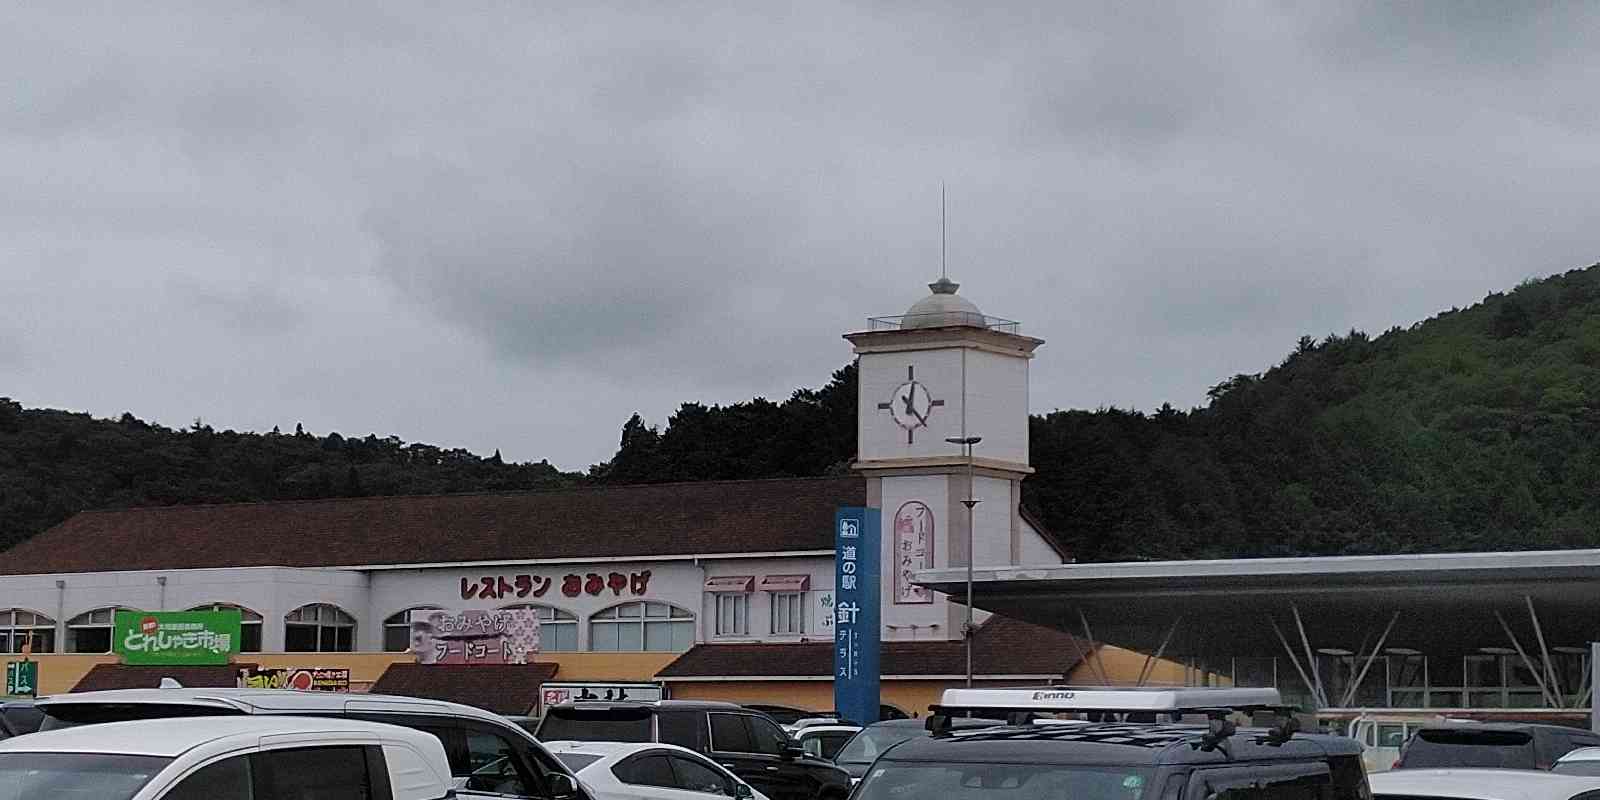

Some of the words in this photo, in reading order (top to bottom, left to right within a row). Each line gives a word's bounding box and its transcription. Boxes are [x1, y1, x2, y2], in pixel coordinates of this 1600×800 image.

[914, 507, 926, 571] フードコー
[842, 545, 857, 591] 道の駅
[460, 576, 552, 599] レストラン
[561, 569, 652, 597] おみやげ
[439, 613, 513, 633] おみやげ
[838, 601, 860, 624] 針
[435, 640, 512, 661] フードコート
[839, 630, 848, 677] テラス
